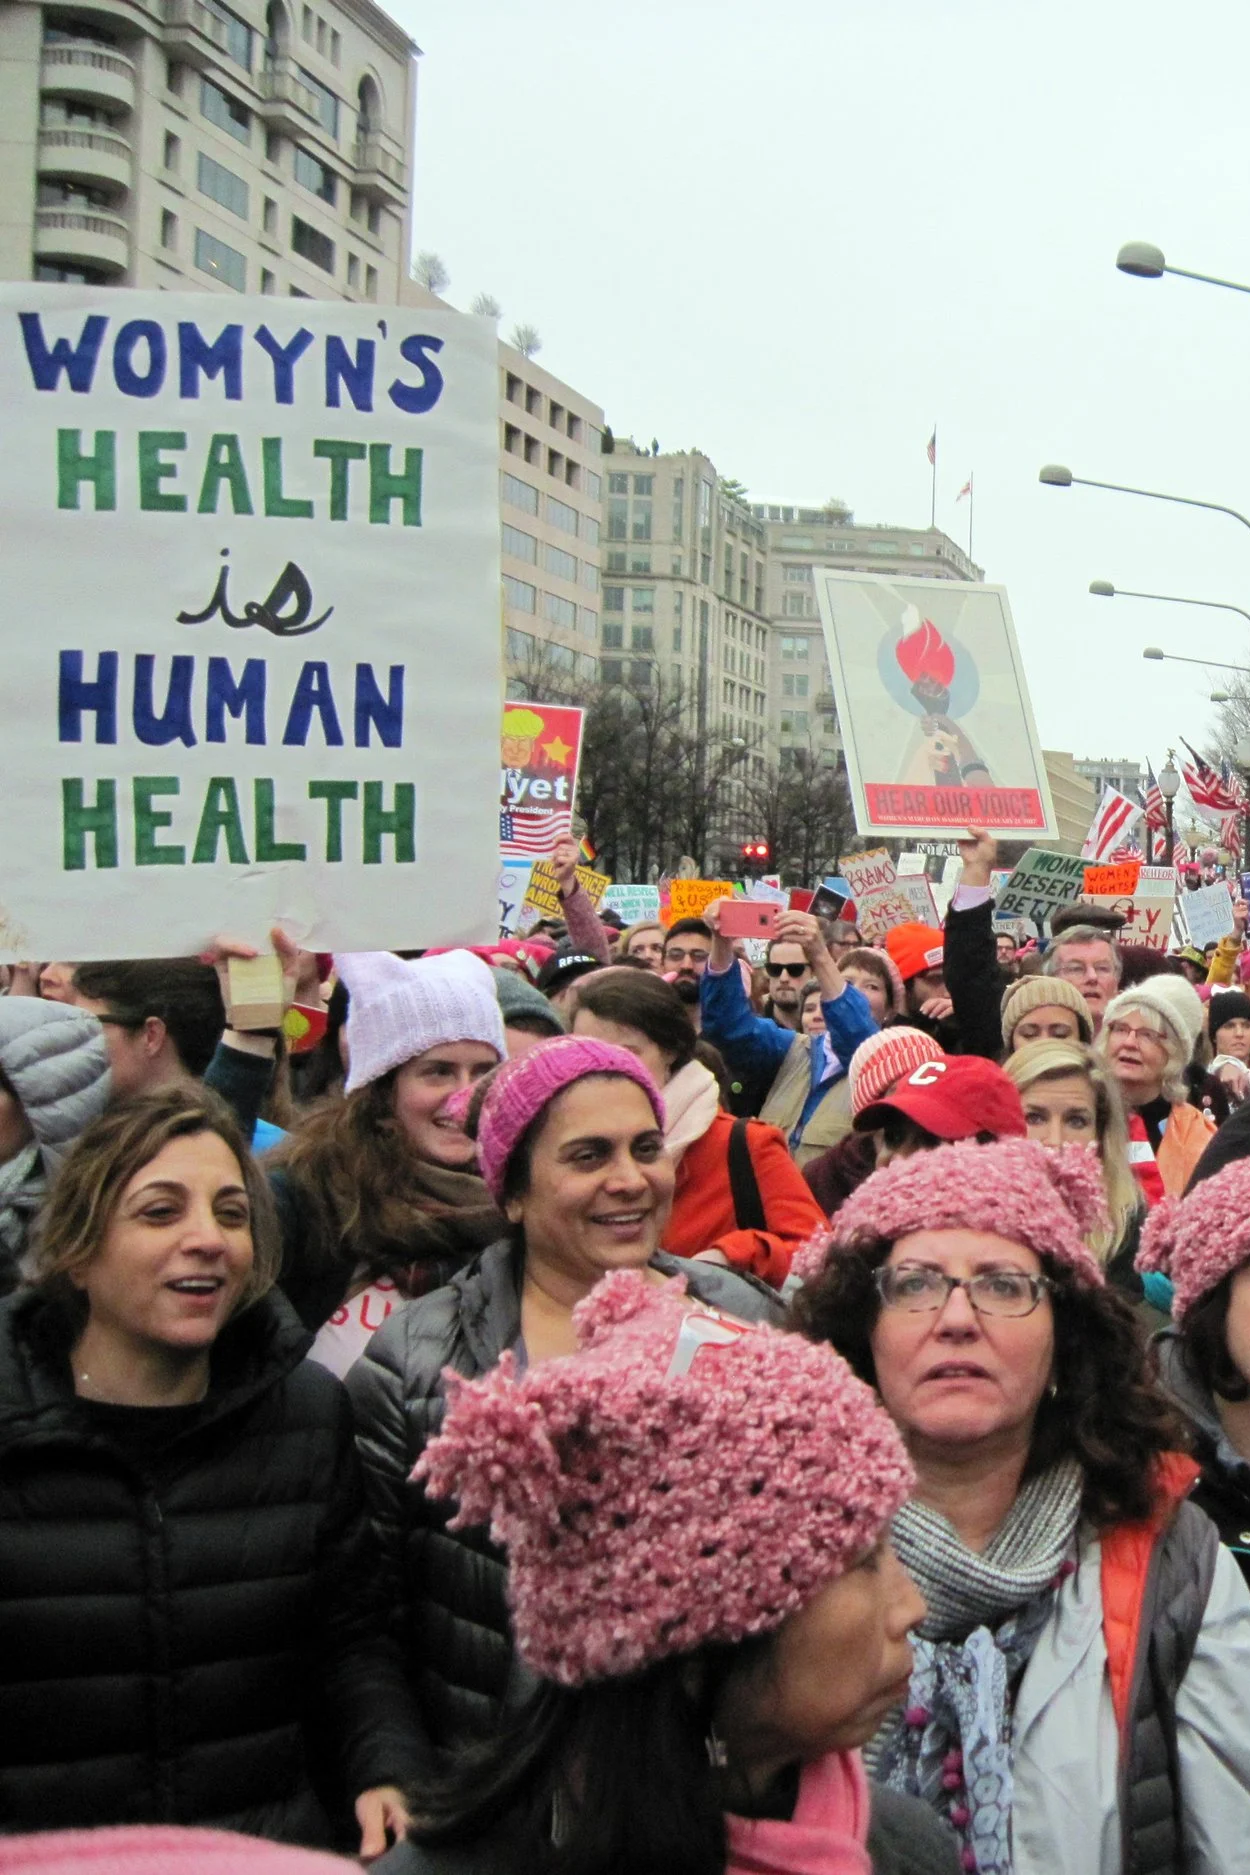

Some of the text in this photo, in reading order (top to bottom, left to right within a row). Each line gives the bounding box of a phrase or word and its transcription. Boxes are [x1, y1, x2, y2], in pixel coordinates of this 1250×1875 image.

[18, 312, 445, 415] WOMYN'S
[57, 427, 424, 528] HEALTH
[176, 547, 334, 636] is
[58, 649, 406, 749] HUMAN
[500, 768, 568, 804] yet
[509, 805, 553, 815] President
[874, 789, 1032, 818] HEAR OUR VOICE
[62, 776, 416, 871] HEALTH
[918, 844, 941, 855] NOT
[1033, 853, 1087, 878] WOME
[845, 860, 896, 898] BRAINS
[1009, 872, 1085, 901] DESERV
[1000, 893, 1063, 919] BETT
[908, 1061, 947, 1086] C
